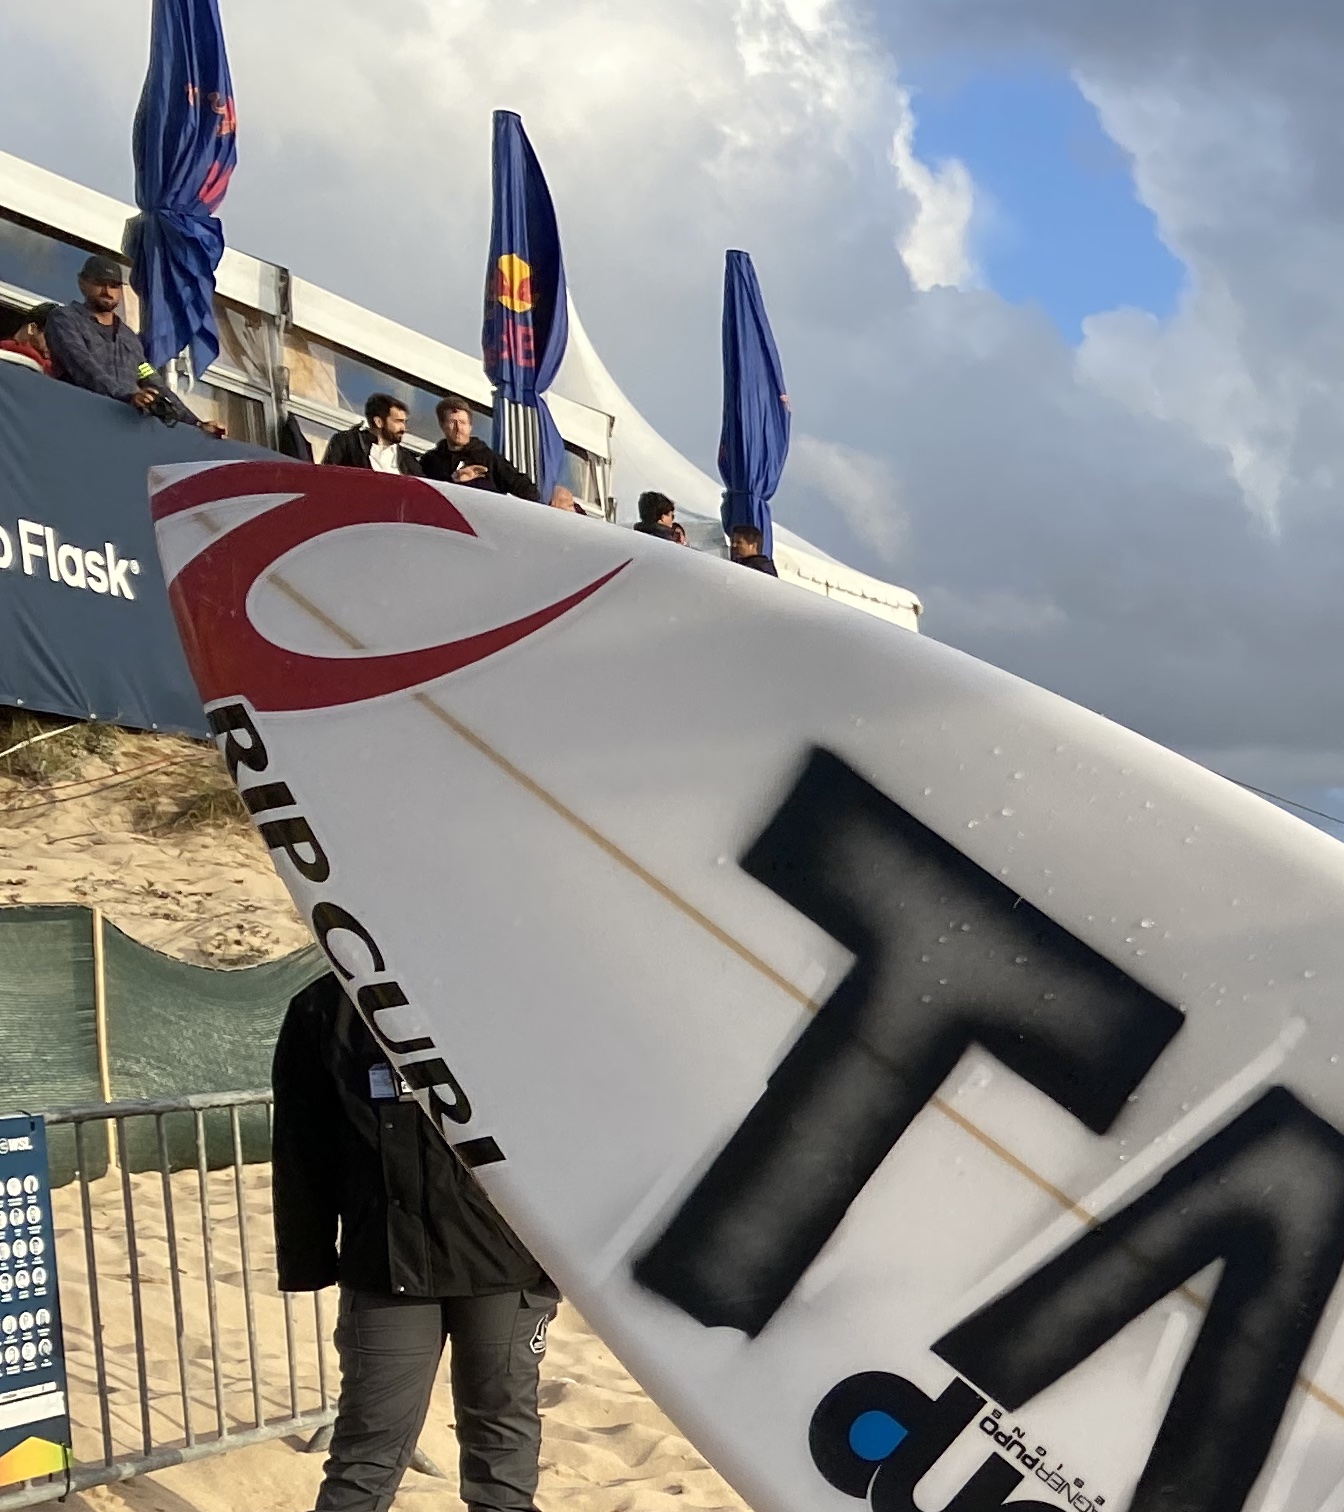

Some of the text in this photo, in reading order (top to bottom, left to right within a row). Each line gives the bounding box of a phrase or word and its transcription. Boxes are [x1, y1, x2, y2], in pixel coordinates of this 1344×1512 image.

[16, 518, 137, 601] Flask
[204, 703, 509, 1174] RIP CURL
